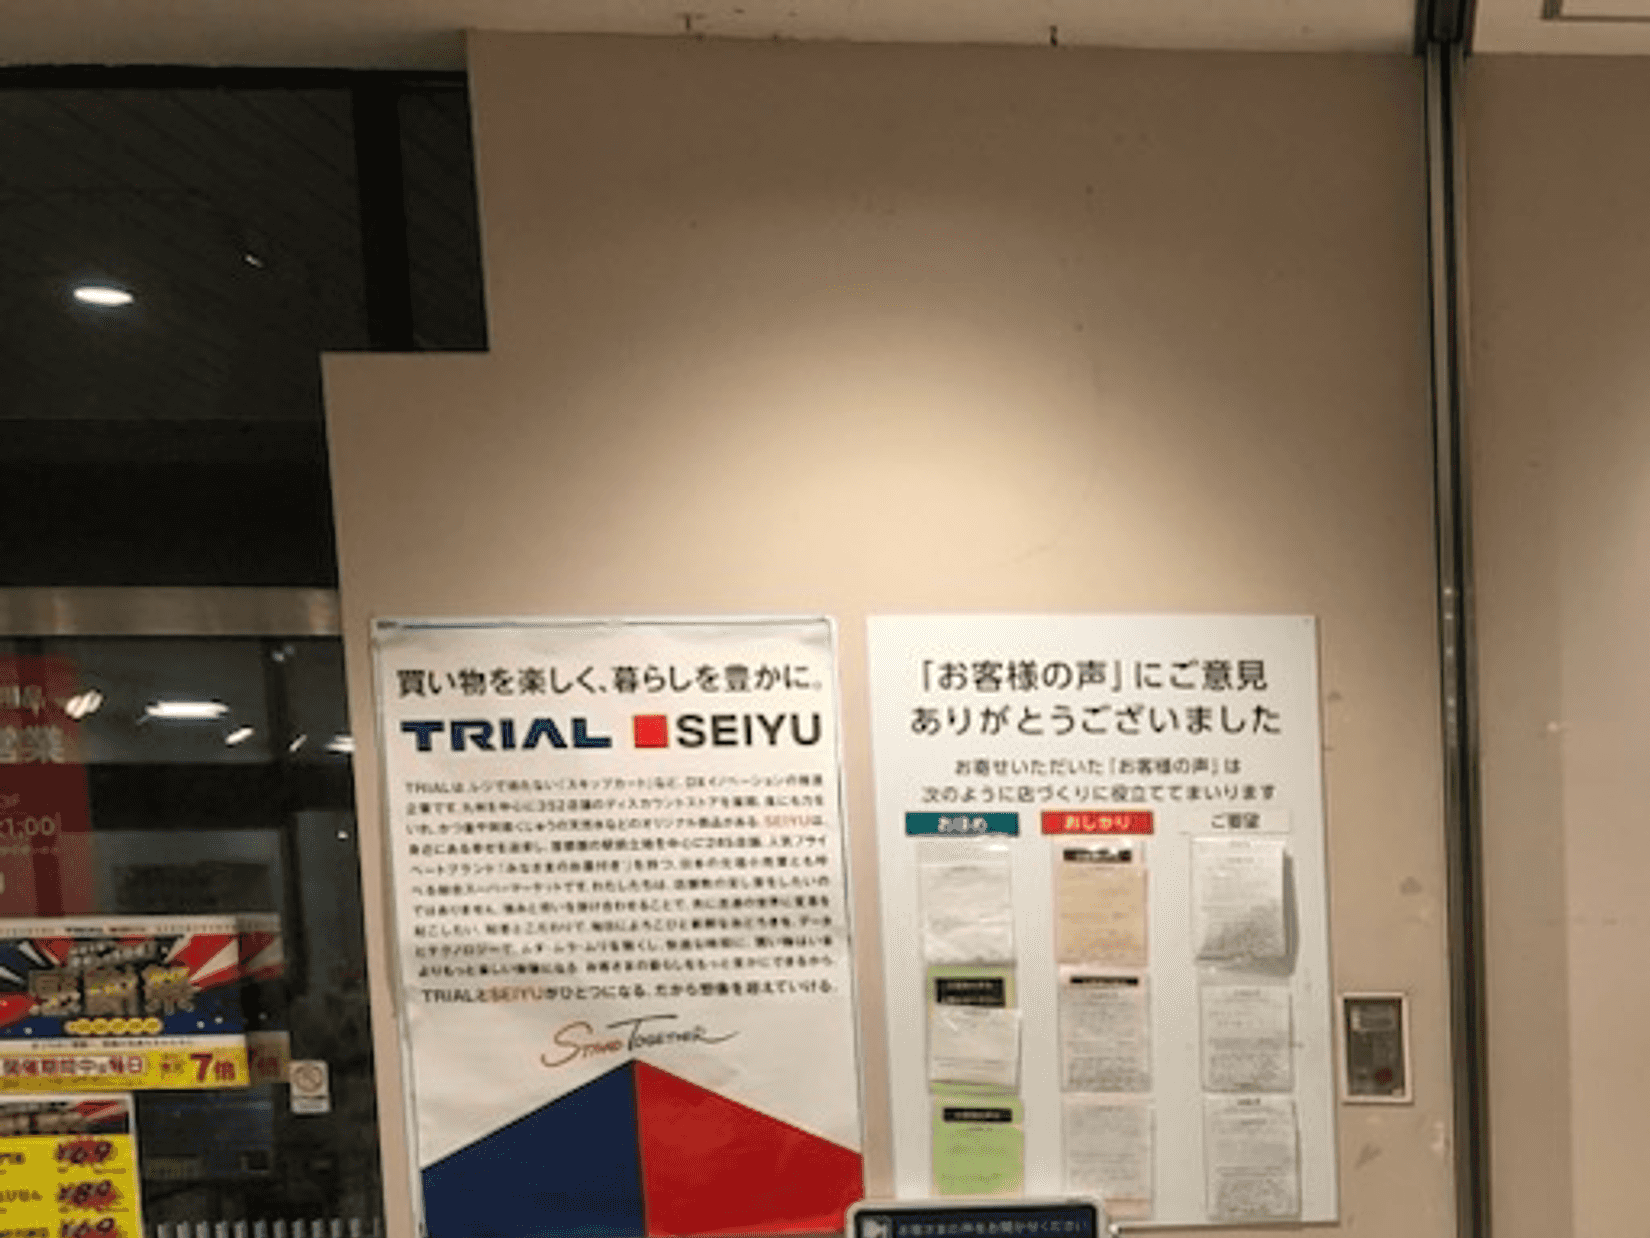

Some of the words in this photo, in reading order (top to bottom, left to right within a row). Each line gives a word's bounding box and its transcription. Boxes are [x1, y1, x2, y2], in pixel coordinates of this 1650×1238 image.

[396, 664, 823, 698] 買い物を楽しく、暮らしを豊かに。
[920, 658, 1269, 692] 「お客様の声」にご意見
[400, 716, 613, 752] TRIAL
[676, 713, 823, 748] SEIYU
[910, 705, 1282, 737] ありがとうございました
[954, 757, 1242, 776] お寄せいただいた「お客様の声」は
